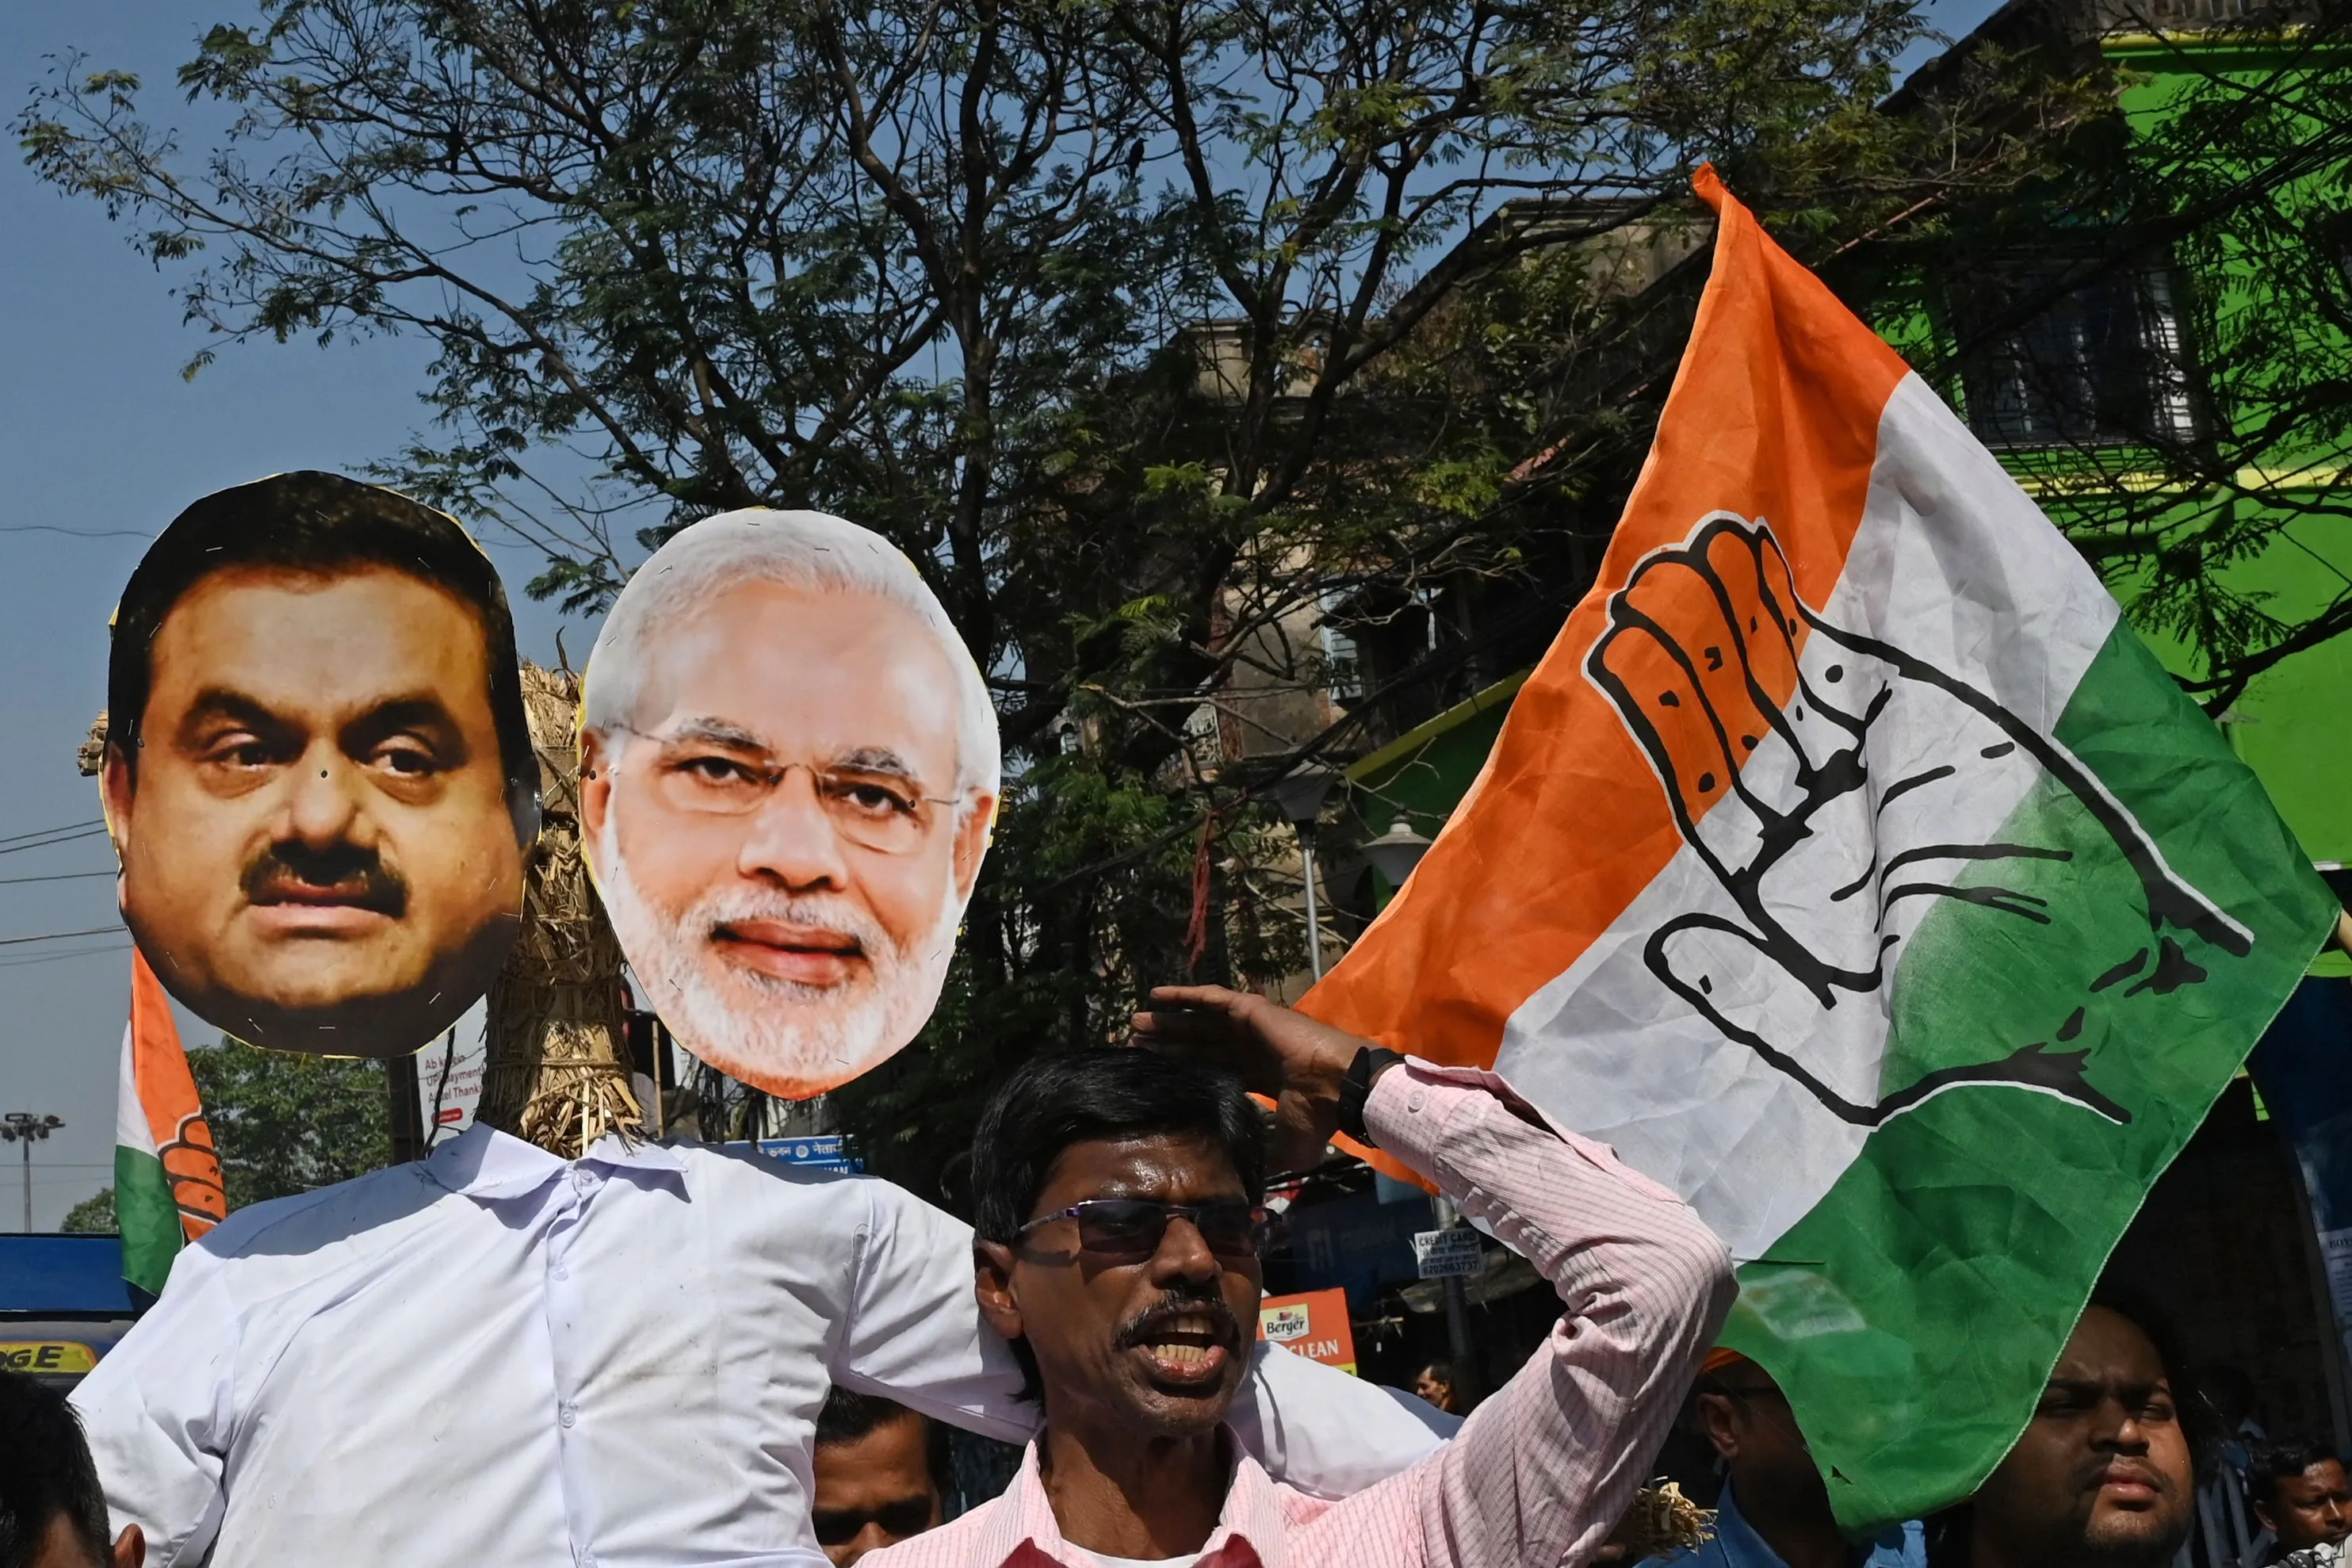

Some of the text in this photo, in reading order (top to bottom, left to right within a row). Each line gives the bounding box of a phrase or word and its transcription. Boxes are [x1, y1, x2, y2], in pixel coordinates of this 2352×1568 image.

[425, 1058, 438, 1070] Ab
[446, 1066, 486, 1084] ayment
[1419, 1231, 1475, 1246] CREDIT CARD
[1266, 1319, 1306, 1336] Berger
